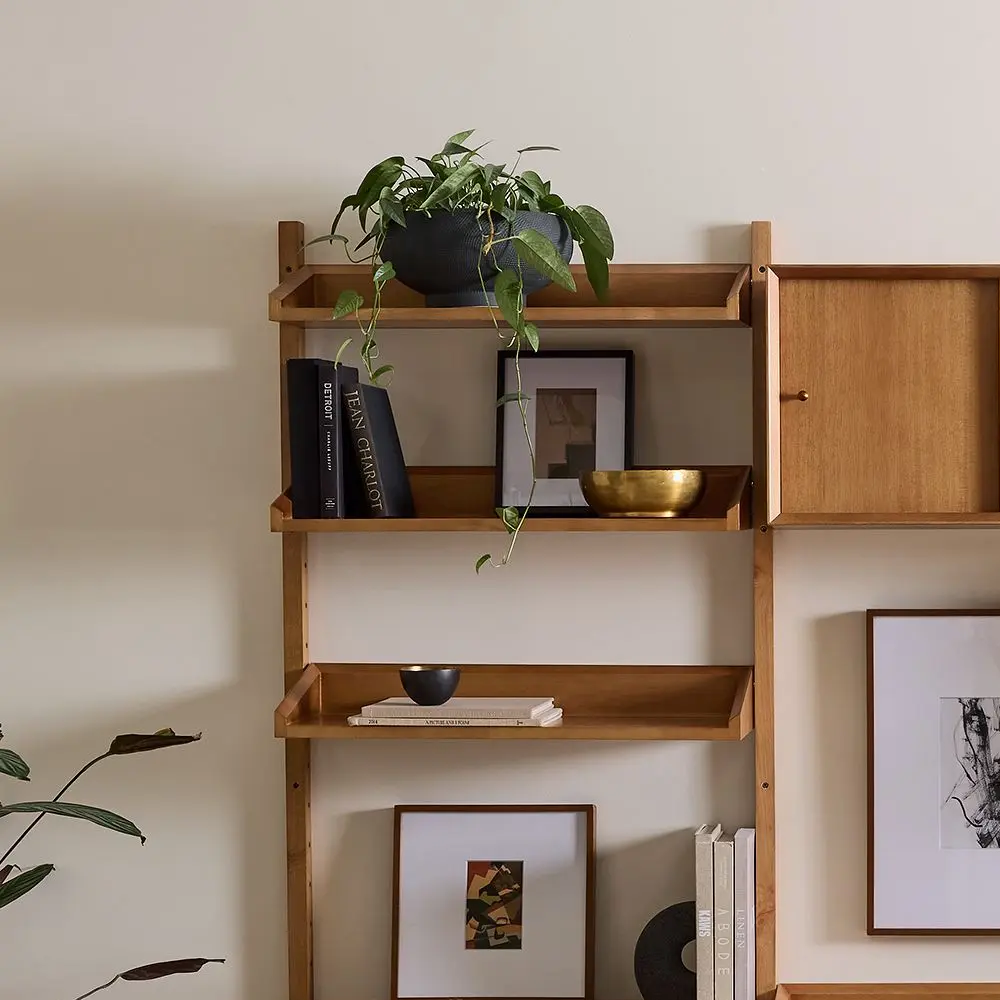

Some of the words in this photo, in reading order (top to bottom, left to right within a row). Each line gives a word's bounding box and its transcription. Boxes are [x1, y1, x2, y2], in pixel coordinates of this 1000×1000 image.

[324, 382, 333, 420] DETROIT
[344, 390, 366, 431] JEAN
[357, 437, 383, 511] CHARLOT
[698, 909, 711, 937] KAWS
[717, 908, 730, 976] ABODE
[736, 909, 745, 949] LINEN
